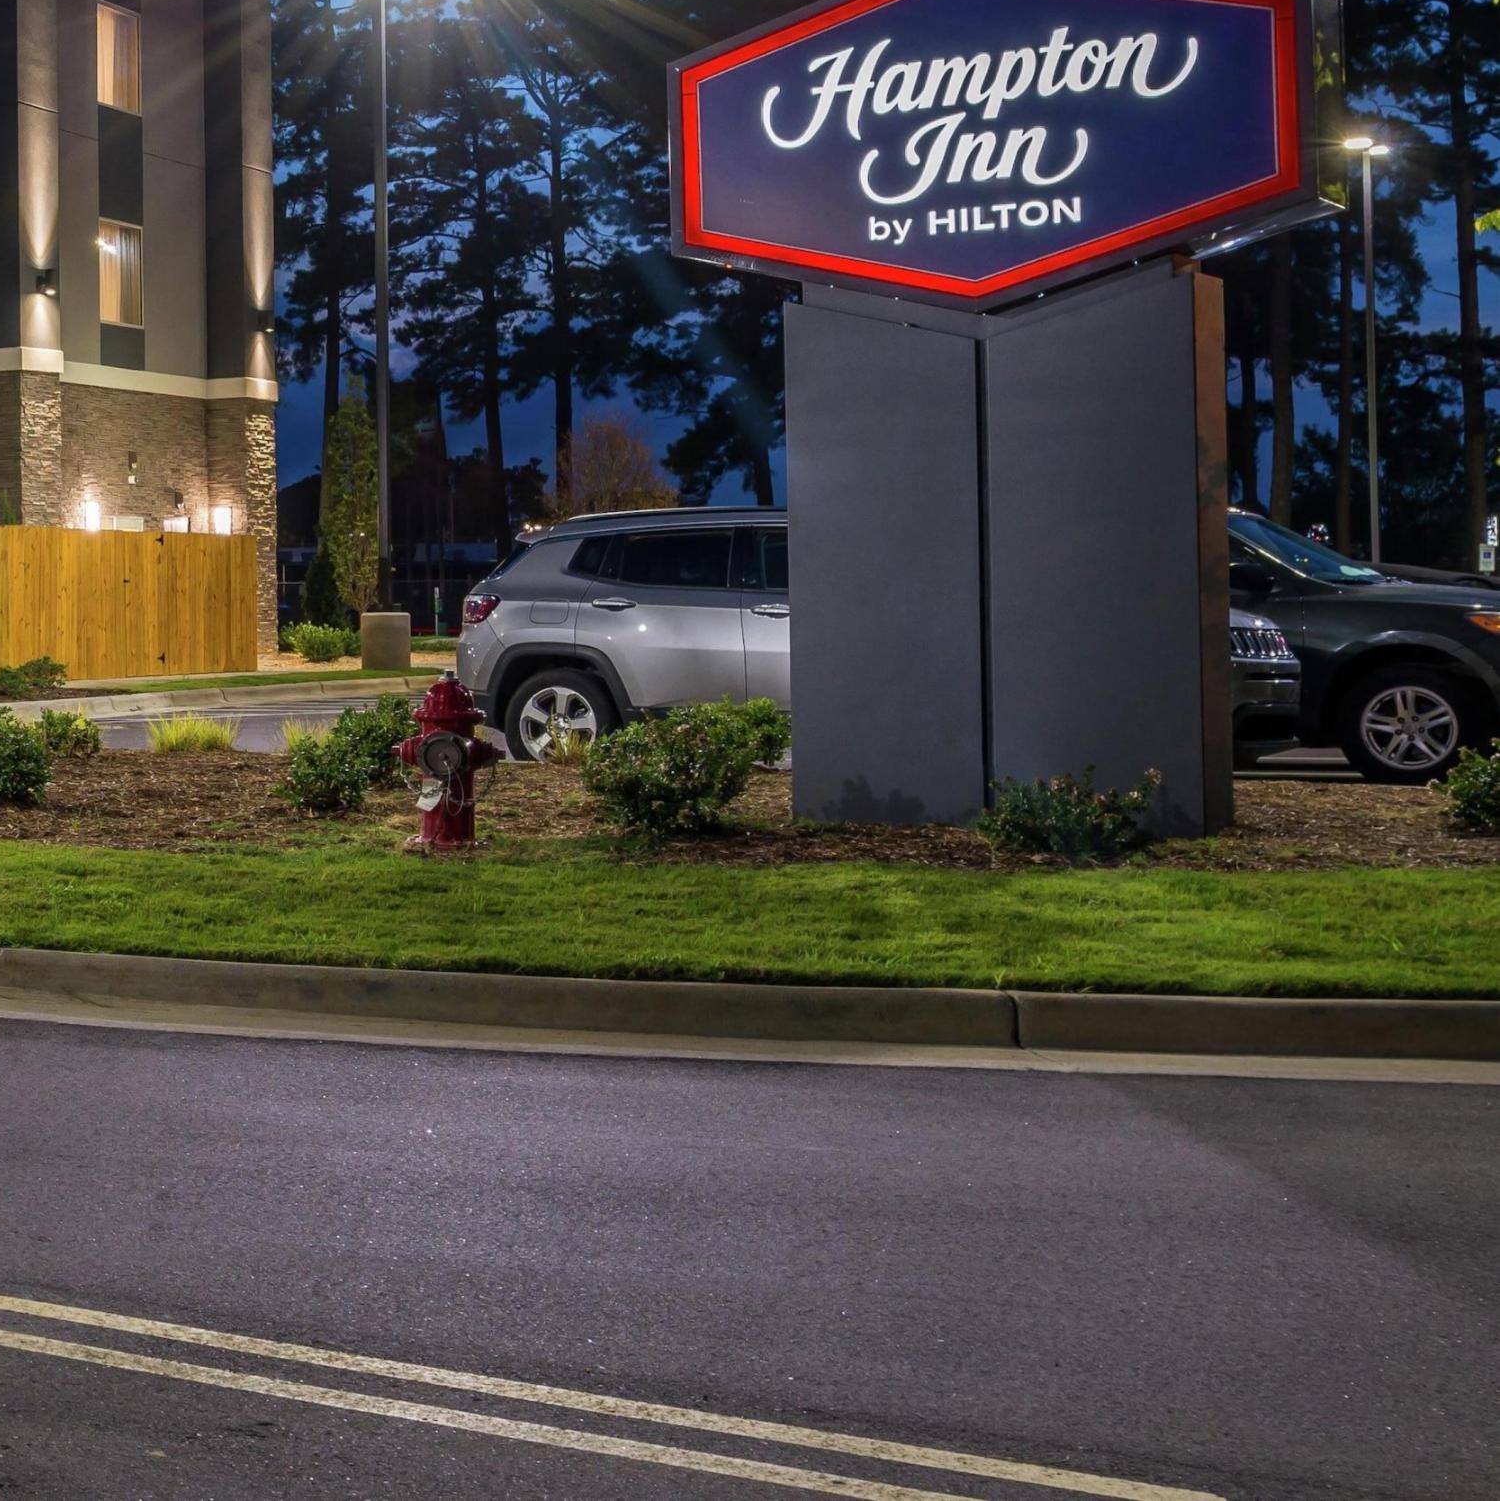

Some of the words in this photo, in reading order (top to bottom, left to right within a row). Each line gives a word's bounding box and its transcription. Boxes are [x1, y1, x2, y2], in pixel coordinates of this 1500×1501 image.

[761, 26, 1199, 149] Hampton
[859, 112, 1088, 206] Inn
[867, 214, 913, 246] by
[927, 196, 1082, 236] HILTON
